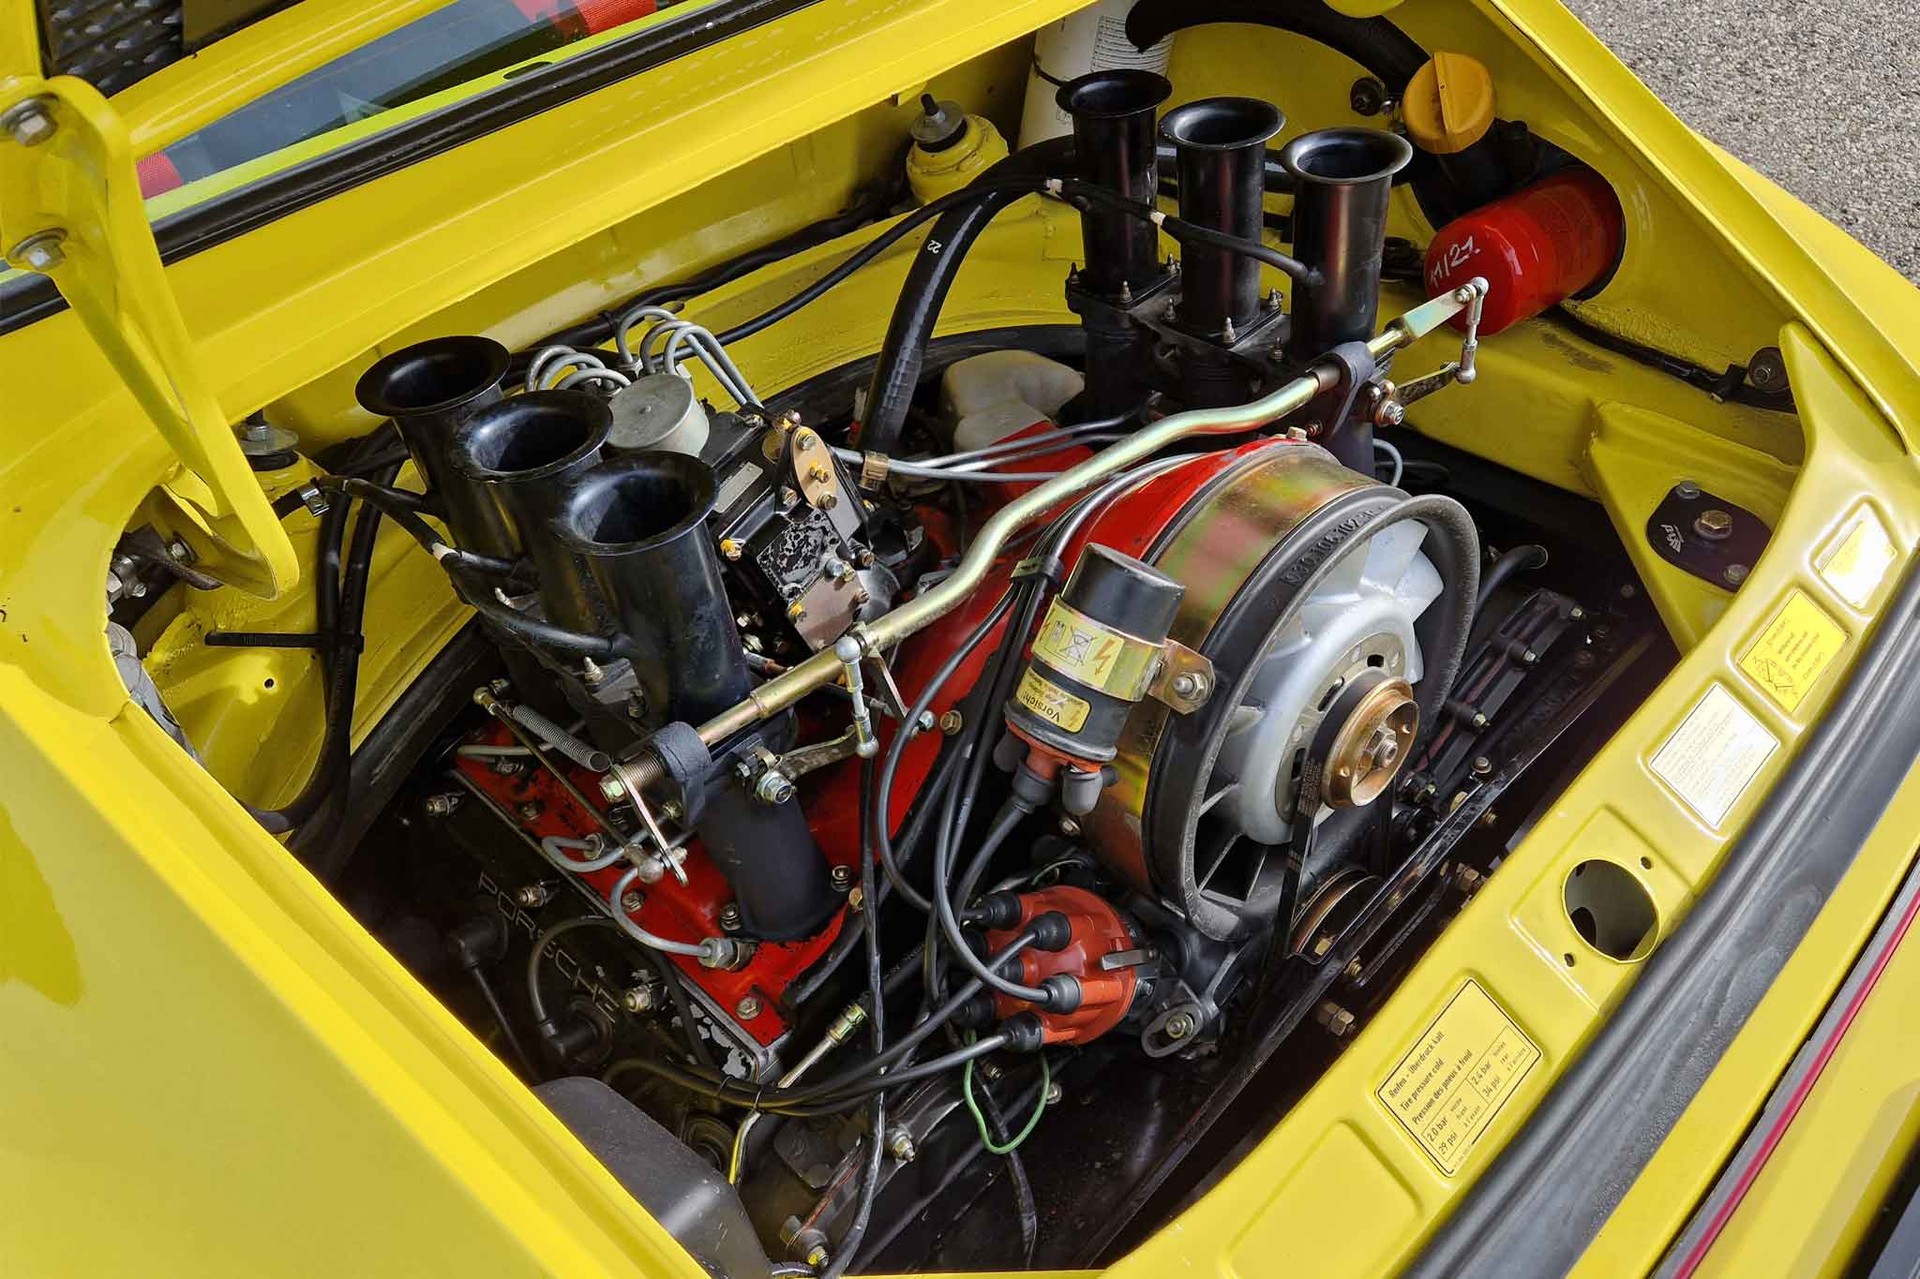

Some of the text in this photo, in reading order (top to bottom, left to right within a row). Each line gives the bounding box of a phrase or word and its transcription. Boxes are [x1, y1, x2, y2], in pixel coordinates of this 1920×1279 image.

[927, 239, 942, 254] 22
[1481, 1061, 1492, 1076] bar
[1388, 1076, 1408, 1099] Reifen
[1400, 1059, 1445, 1112] Tire pressure cold
[1412, 1095, 1434, 1125] Pression
[1433, 1083, 1444, 1099] des
[1442, 1068, 1458, 1091] pneus
[1459, 1049, 1473, 1067] froid
[1483, 1076, 1501, 1098] 34 psi
[1427, 1116, 1448, 1142] 2.0 bar
[1438, 1131, 1458, 1155] 29 psi
